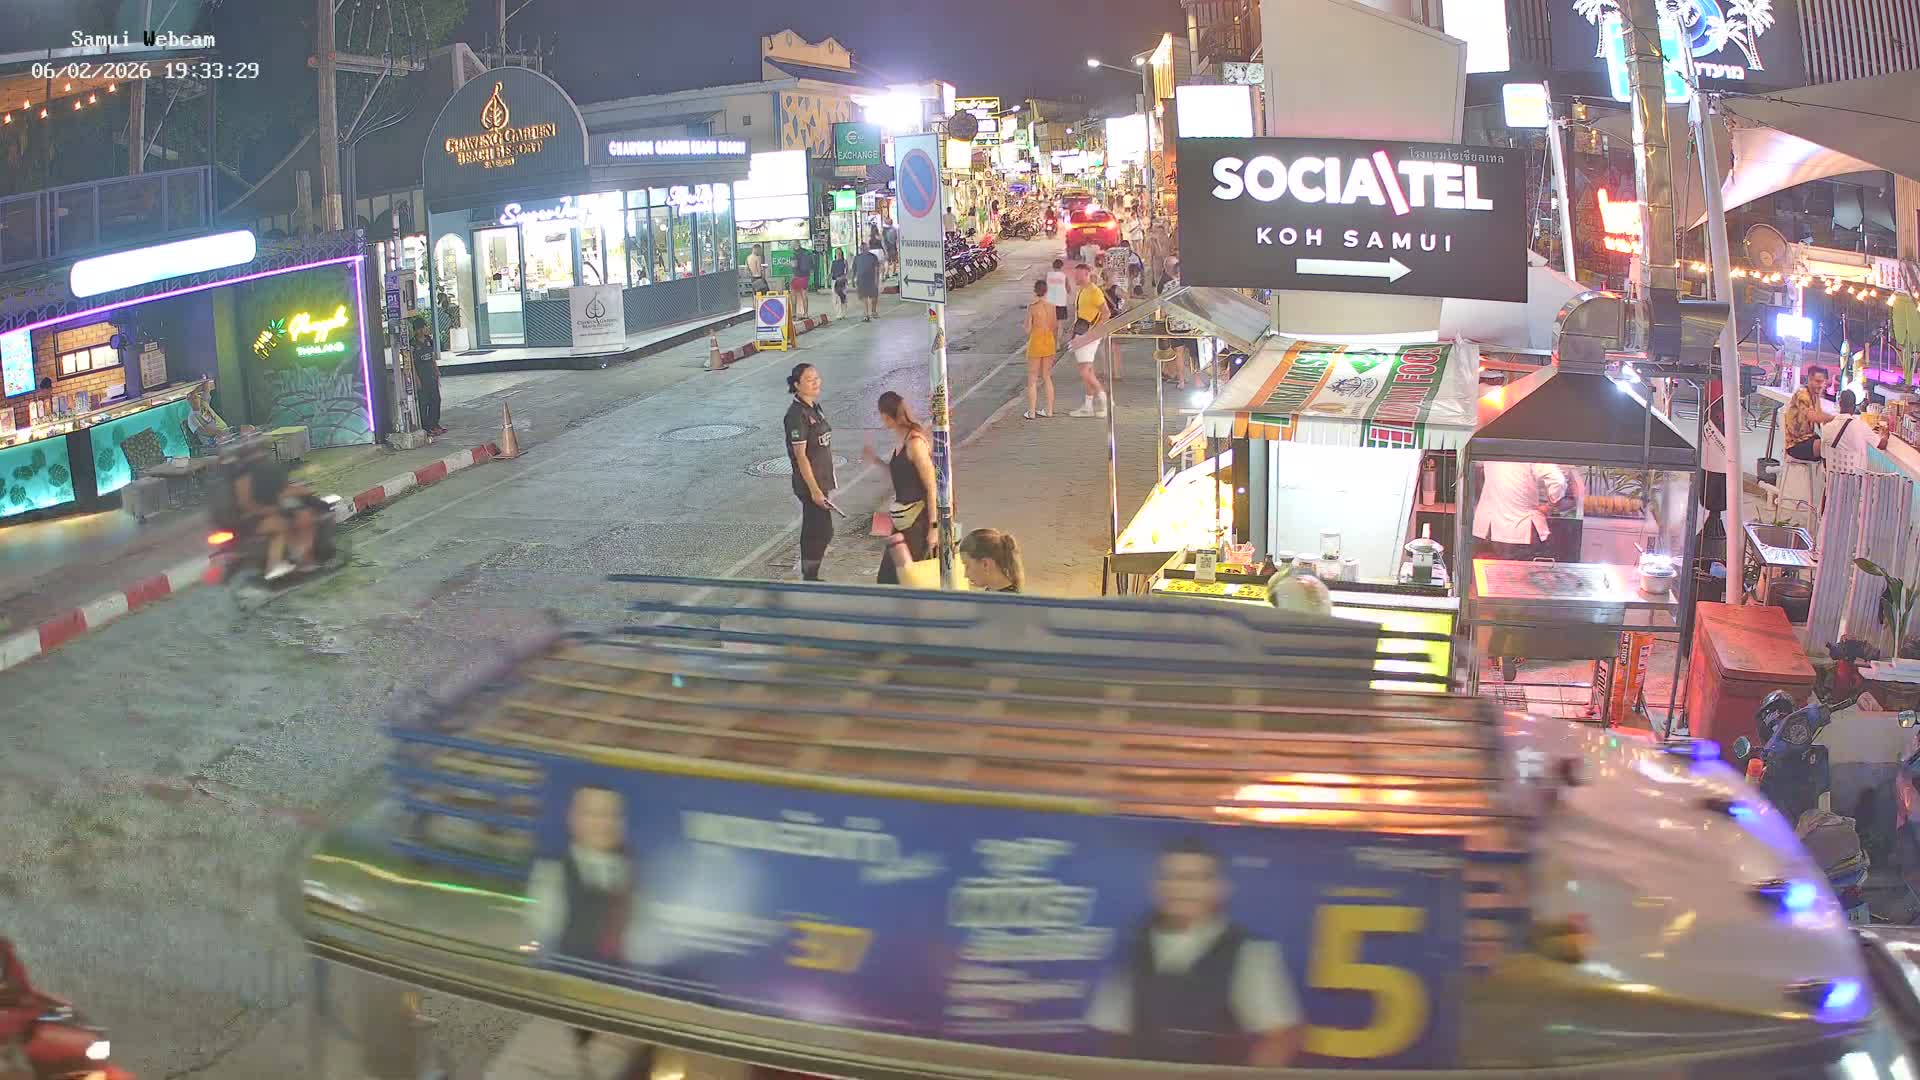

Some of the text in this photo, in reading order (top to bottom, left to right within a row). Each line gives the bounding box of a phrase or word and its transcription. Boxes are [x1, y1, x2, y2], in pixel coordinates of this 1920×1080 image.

[838, 150, 878, 160] EXCHANGE
[1256, 227, 1452, 252] KOH SAMUI
[905, 258, 937, 269] NO PARKING
[1305, 902, 1432, 1060] 5
